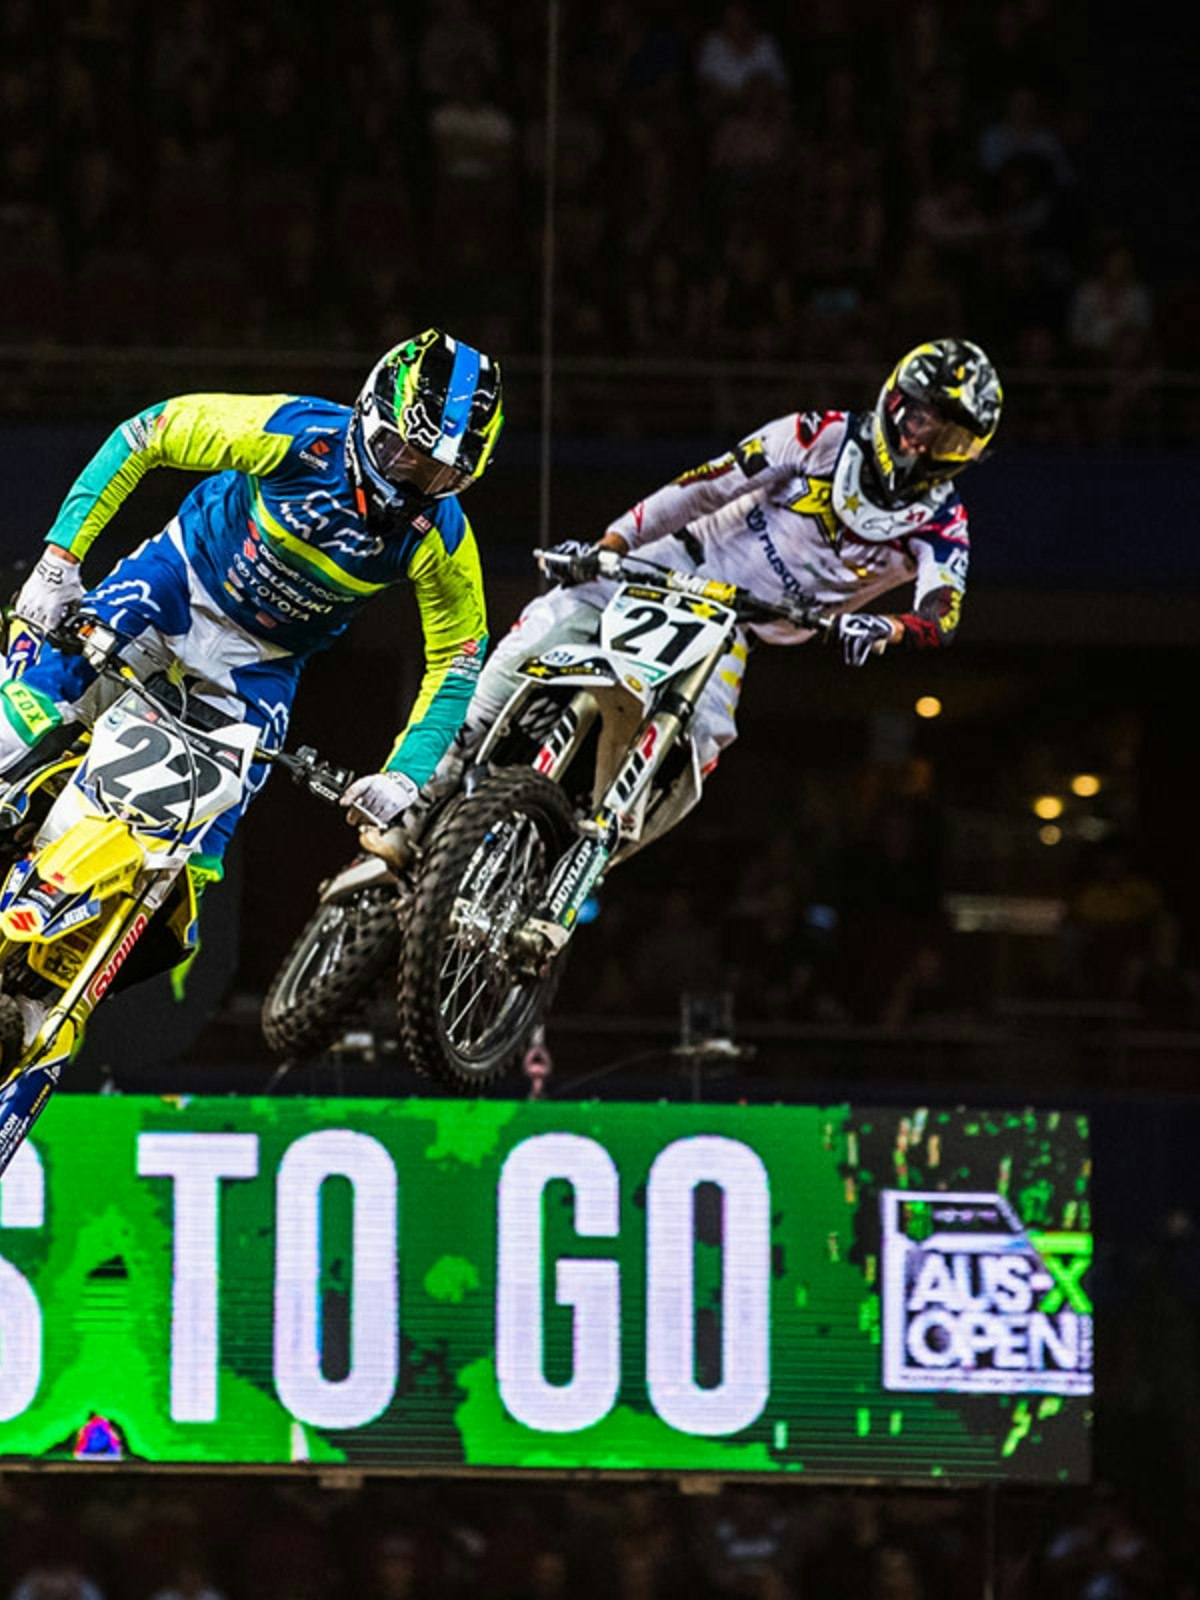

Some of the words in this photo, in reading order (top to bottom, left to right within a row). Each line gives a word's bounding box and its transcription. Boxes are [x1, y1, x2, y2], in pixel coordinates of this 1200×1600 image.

[249, 577, 311, 622] TOYOTA
[255, 562, 334, 614] SUZUKI
[610, 605, 707, 666] 21
[10, 688, 44, 723] FOX
[88, 724, 223, 825] 22
[549, 840, 592, 919] DUNLOP
[137, 1129, 399, 1430] TO
[496, 1132, 771, 1437] GO
[907, 1252, 1094, 1315] AUS-X
[906, 1309, 1080, 1371] OPEN
